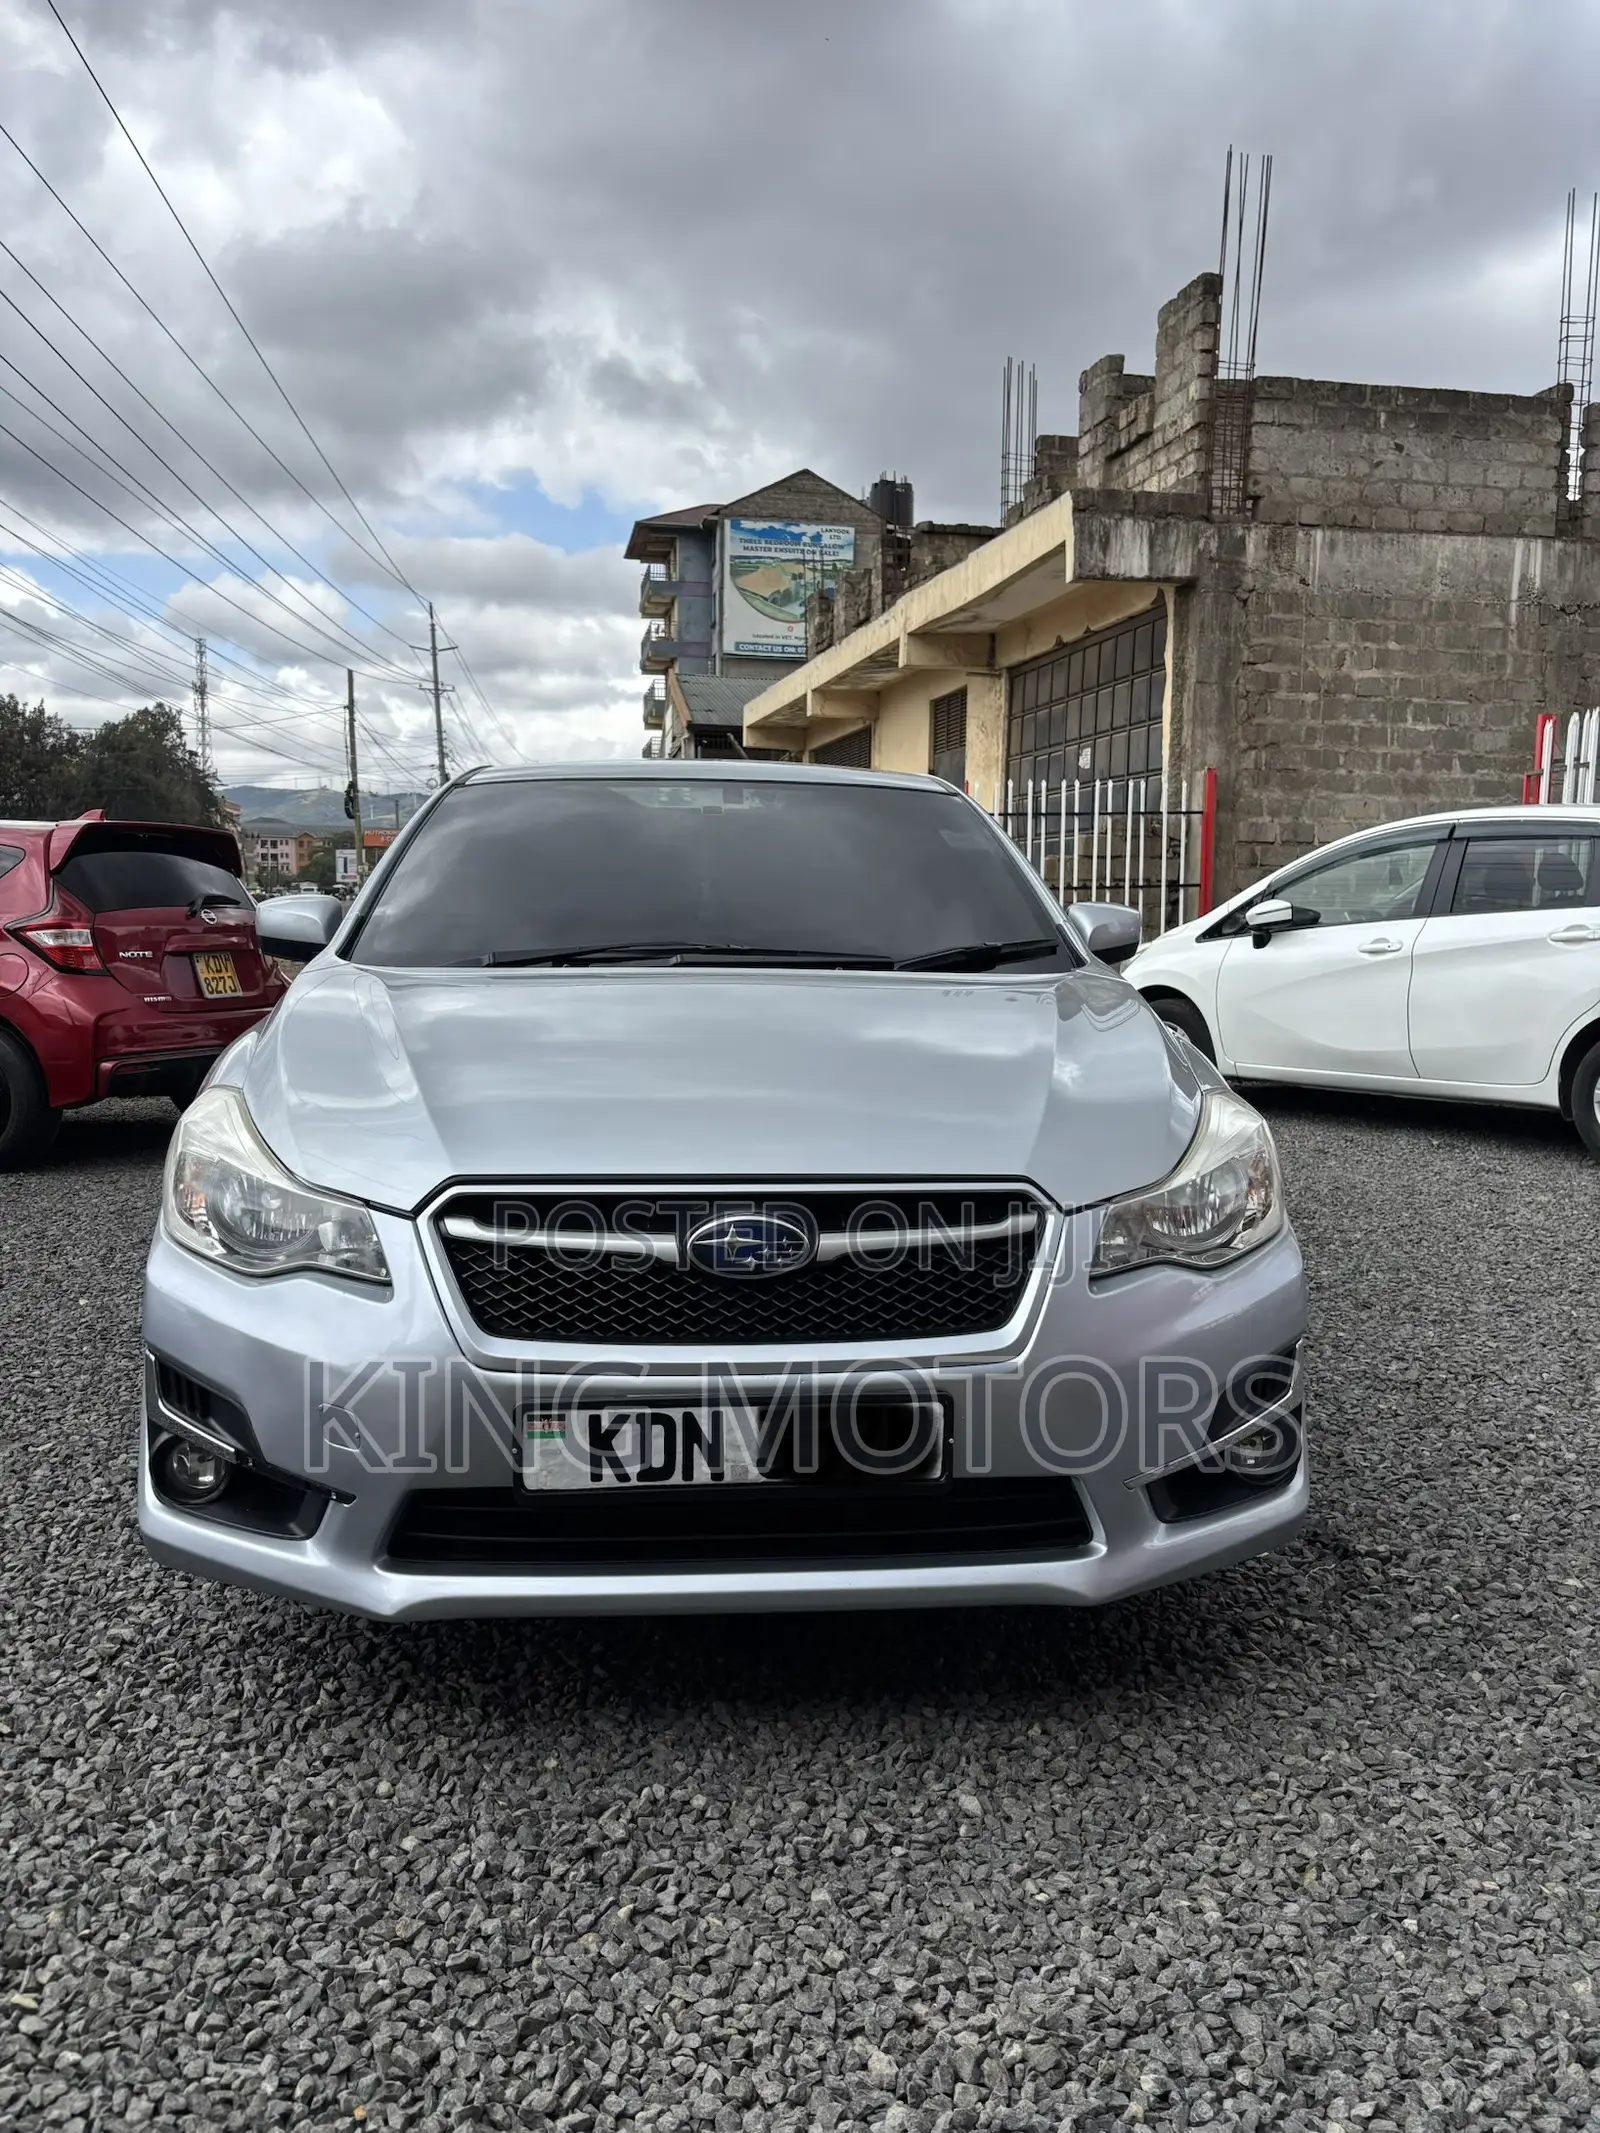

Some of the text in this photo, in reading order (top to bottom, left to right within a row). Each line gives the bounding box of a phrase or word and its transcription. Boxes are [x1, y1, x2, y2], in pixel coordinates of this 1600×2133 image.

[743, 545, 773, 553] MASTER
[774, 547, 805, 555] ENSUITE
[765, 539, 801, 547] BEDROOM
[802, 541, 845, 550] BUNGALOW
[739, 643, 772, 652] CONTACT
[204, 976, 237, 995] 827J
[588, 1409, 725, 1483] KDN
